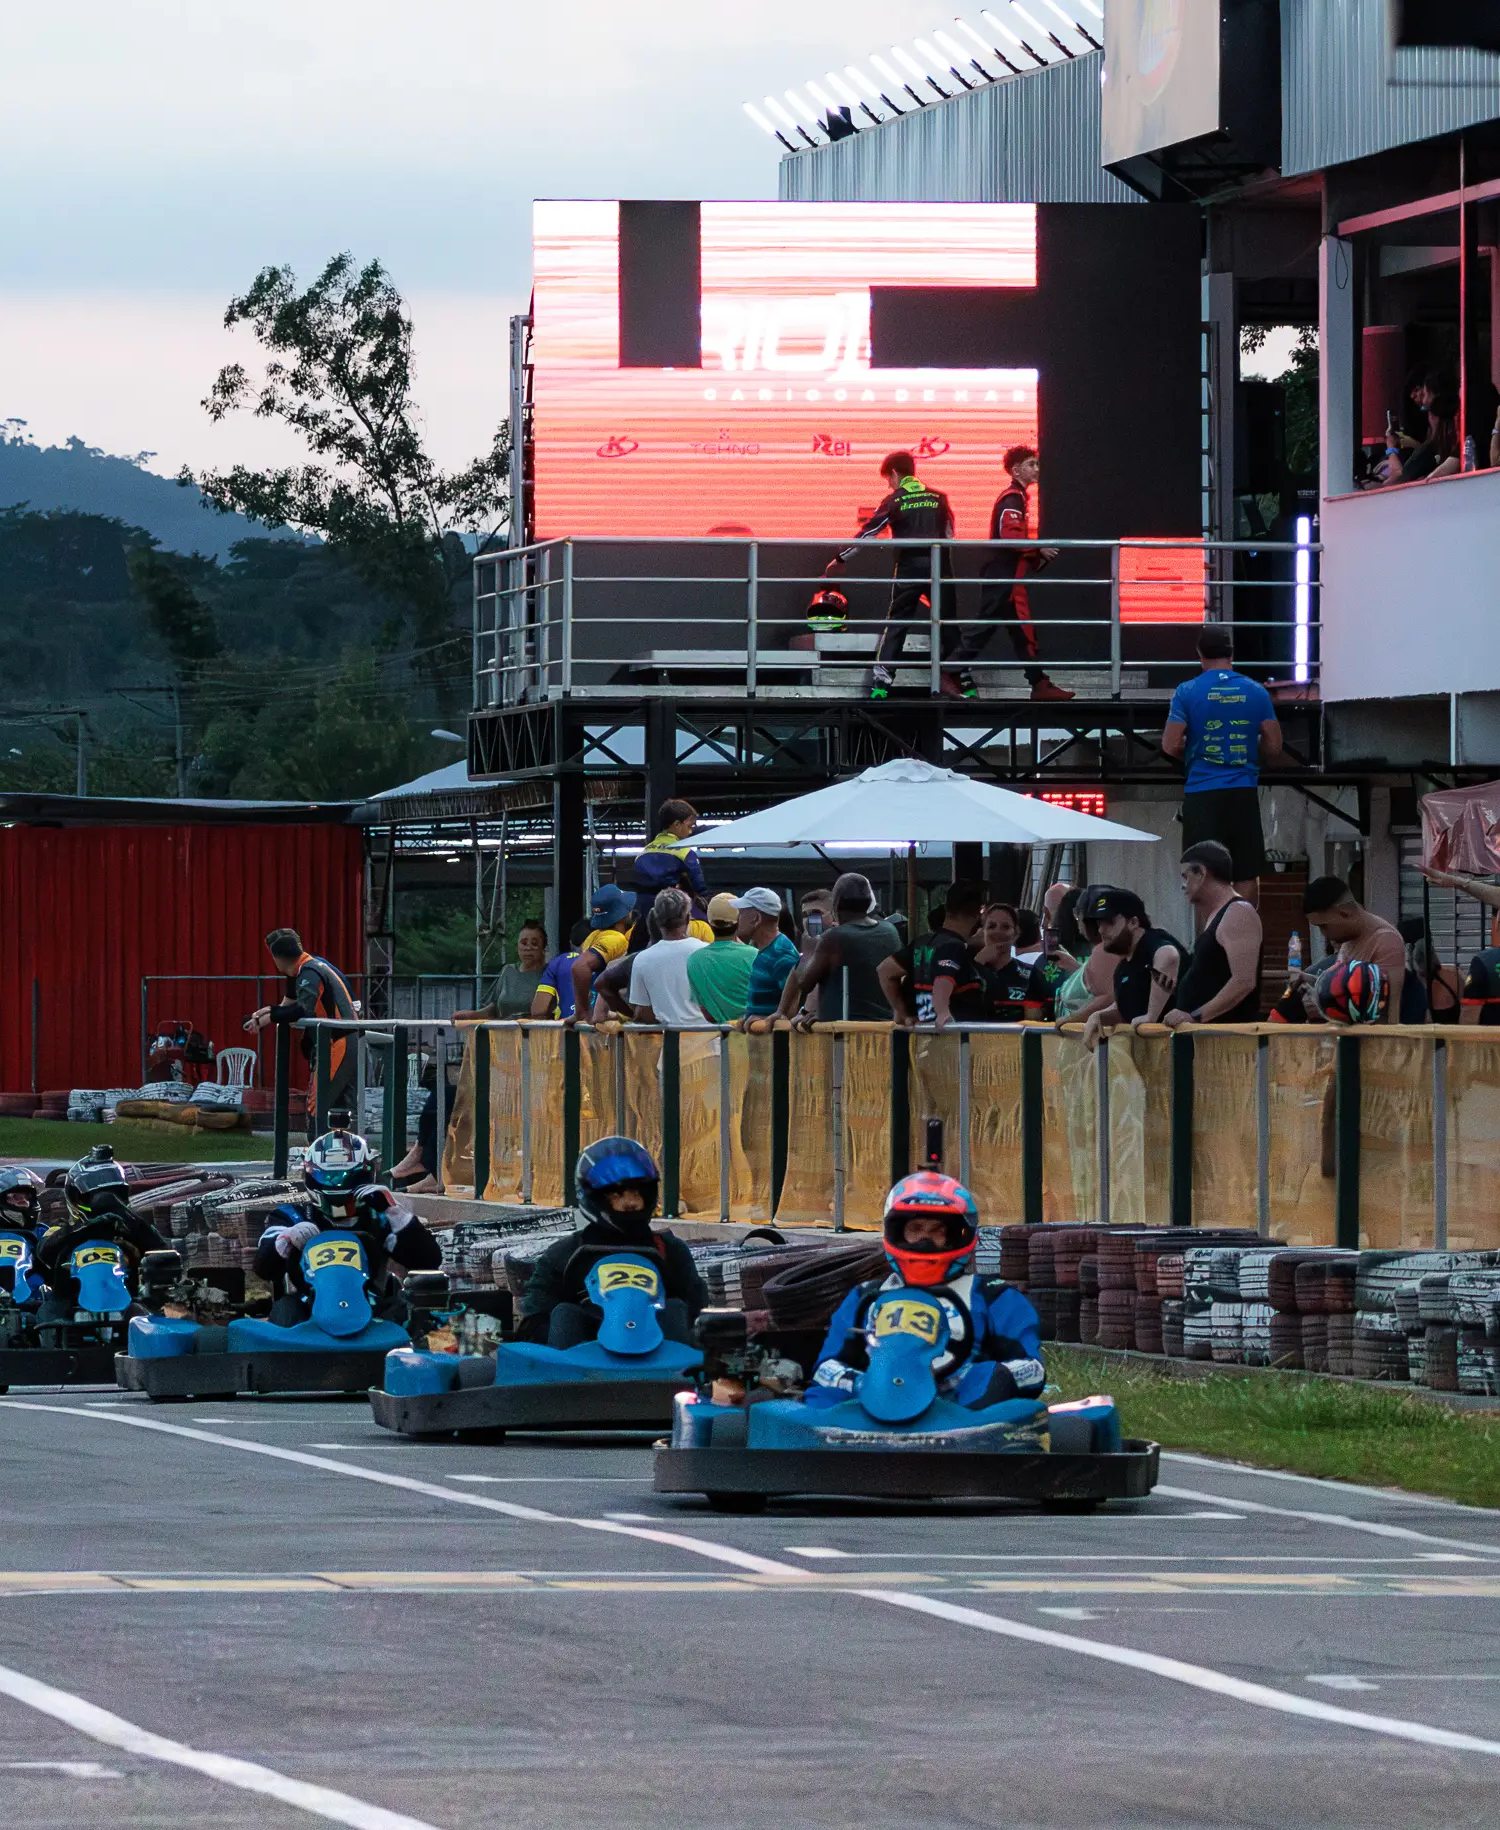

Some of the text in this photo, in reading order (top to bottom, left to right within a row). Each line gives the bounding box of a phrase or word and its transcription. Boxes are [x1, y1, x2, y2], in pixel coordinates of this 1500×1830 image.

[82, 1252, 120, 1264] 03
[316, 1247, 358, 1266] 37
[606, 1270, 654, 1289] 23
[886, 1307, 935, 1334] 13
